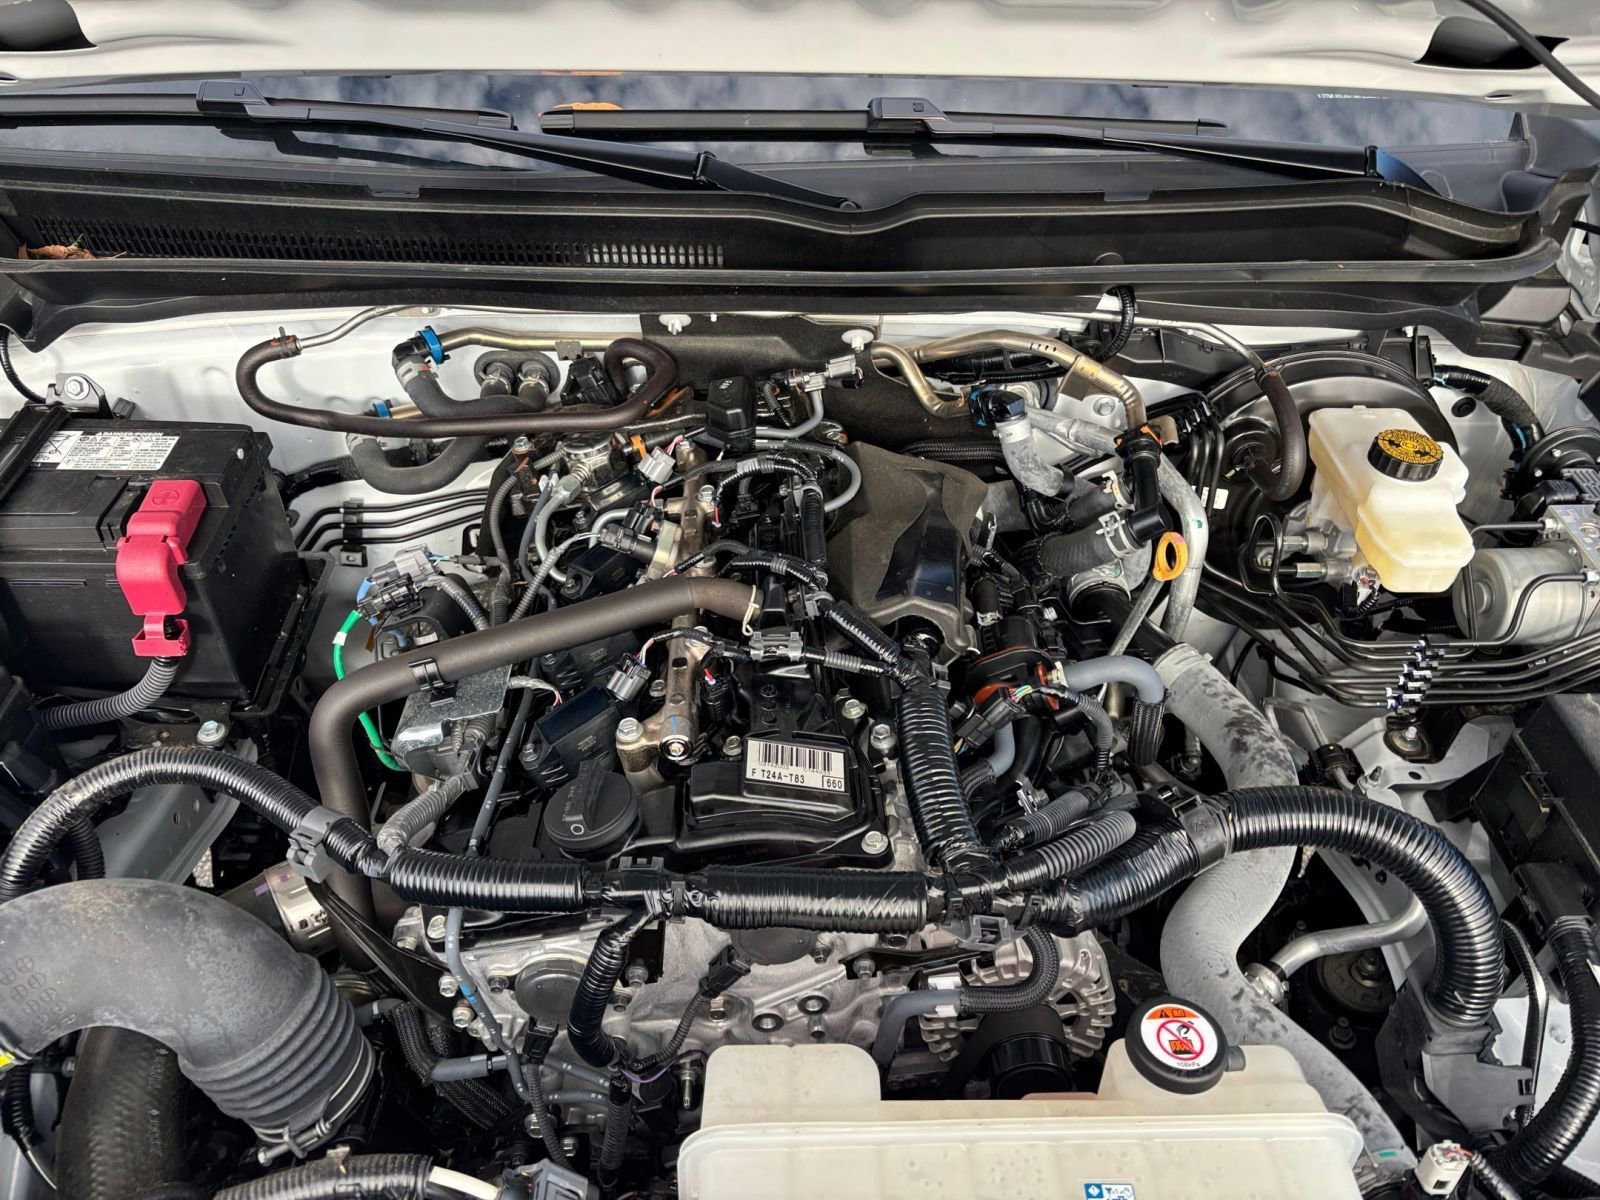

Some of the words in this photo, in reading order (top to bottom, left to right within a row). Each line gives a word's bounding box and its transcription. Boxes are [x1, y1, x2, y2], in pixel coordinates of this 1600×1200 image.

[751, 768, 757, 777] F
[761, 769, 805, 784] T24A-T83
[826, 778, 843, 790] 660
